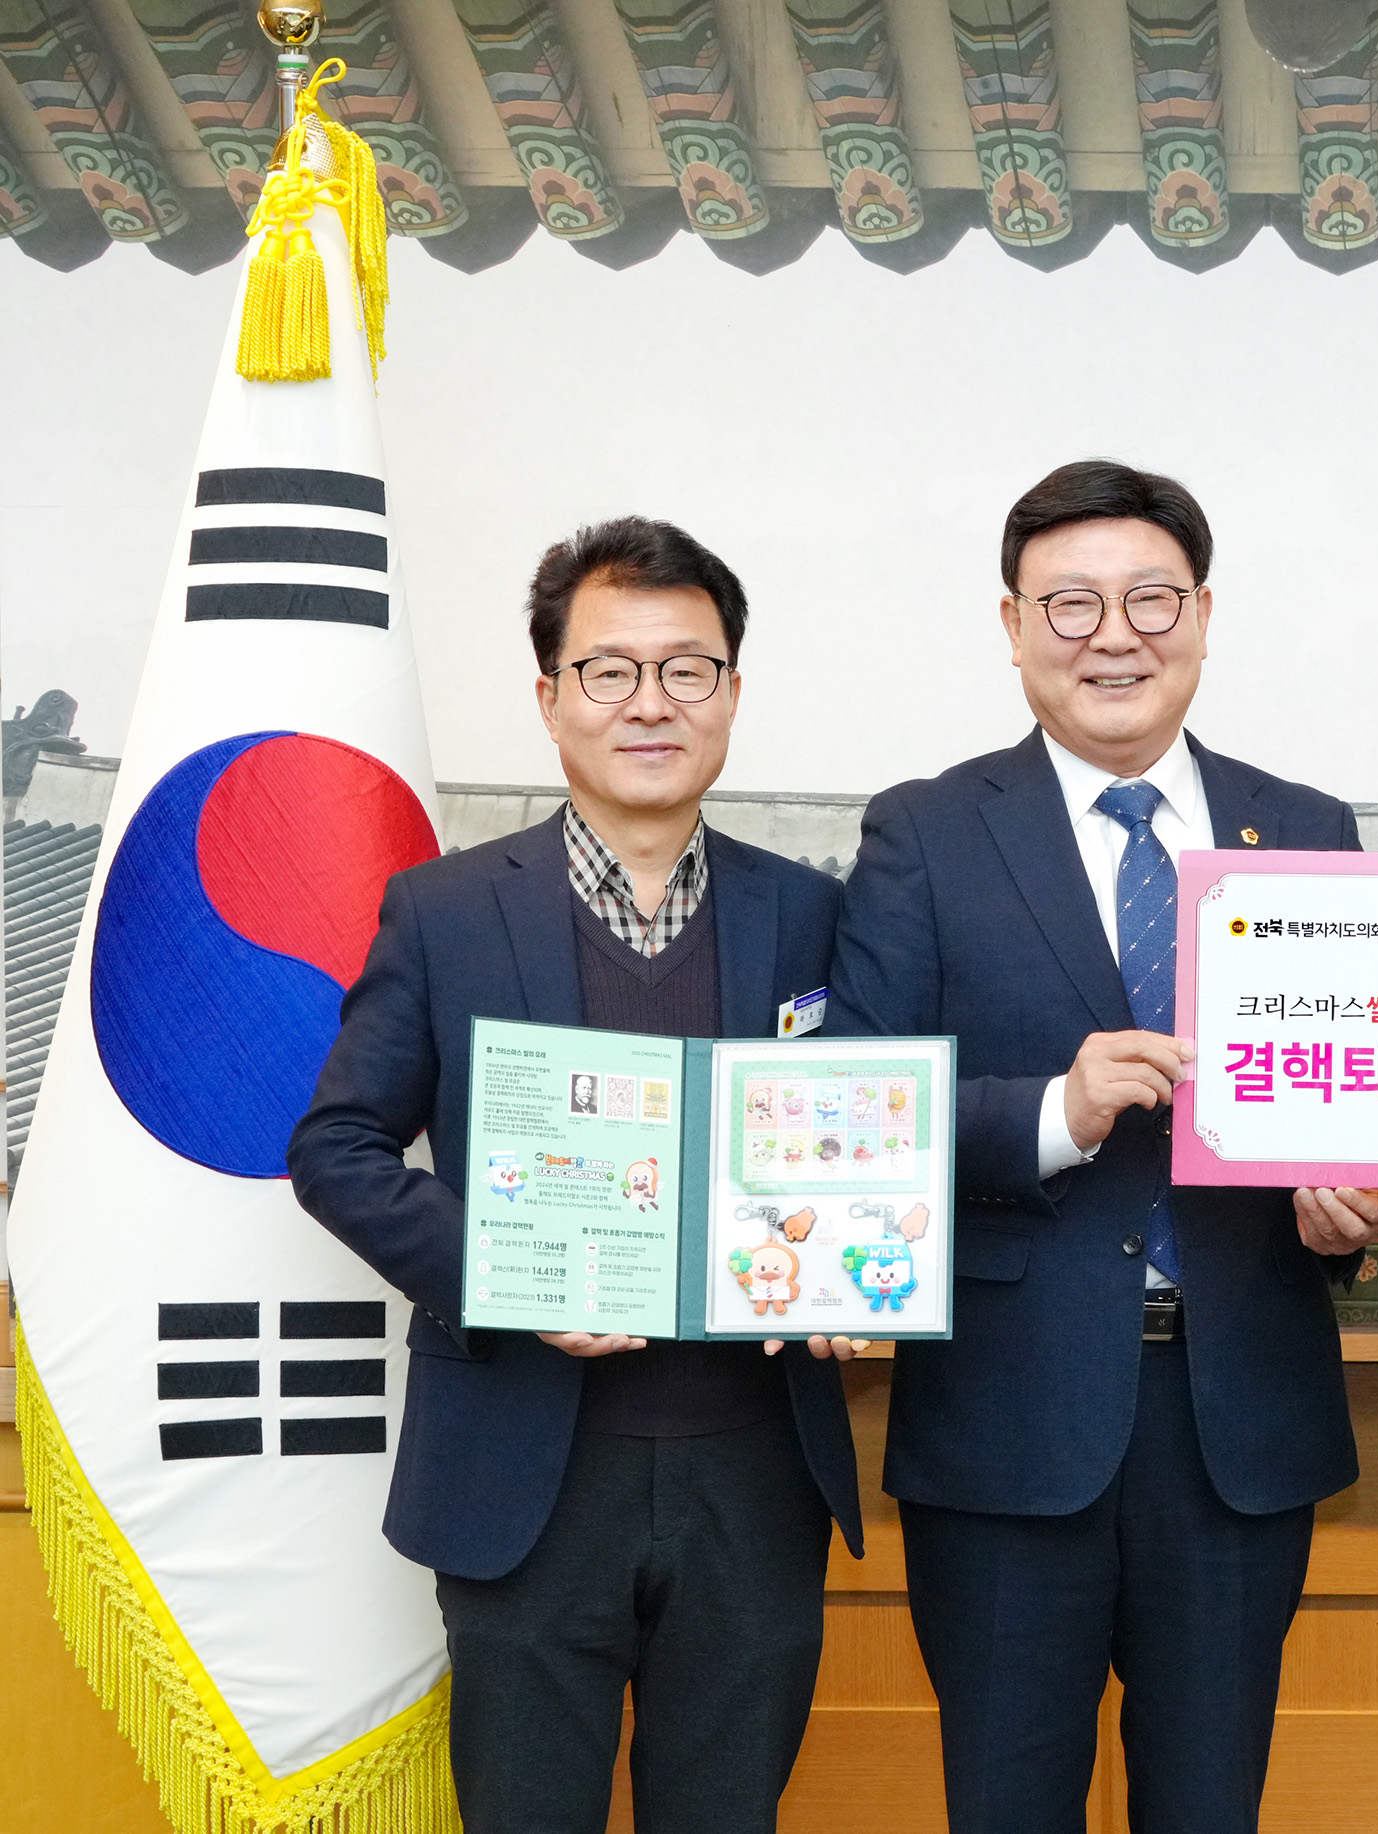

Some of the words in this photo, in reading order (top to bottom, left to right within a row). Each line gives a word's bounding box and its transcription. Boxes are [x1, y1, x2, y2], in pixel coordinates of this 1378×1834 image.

[1253, 919, 1284, 938] 전북
[495, 1046, 522, 1056] 크리스마스
[535, 1167, 560, 1177] LUCKY
[561, 1169, 605, 1180] CHRISTMAS
[533, 1241, 567, 1252] 17,944명
[869, 1247, 904, 1258] WILK
[532, 1267, 566, 1277] 14,412명
[536, 1294, 566, 1304] 1,331명
